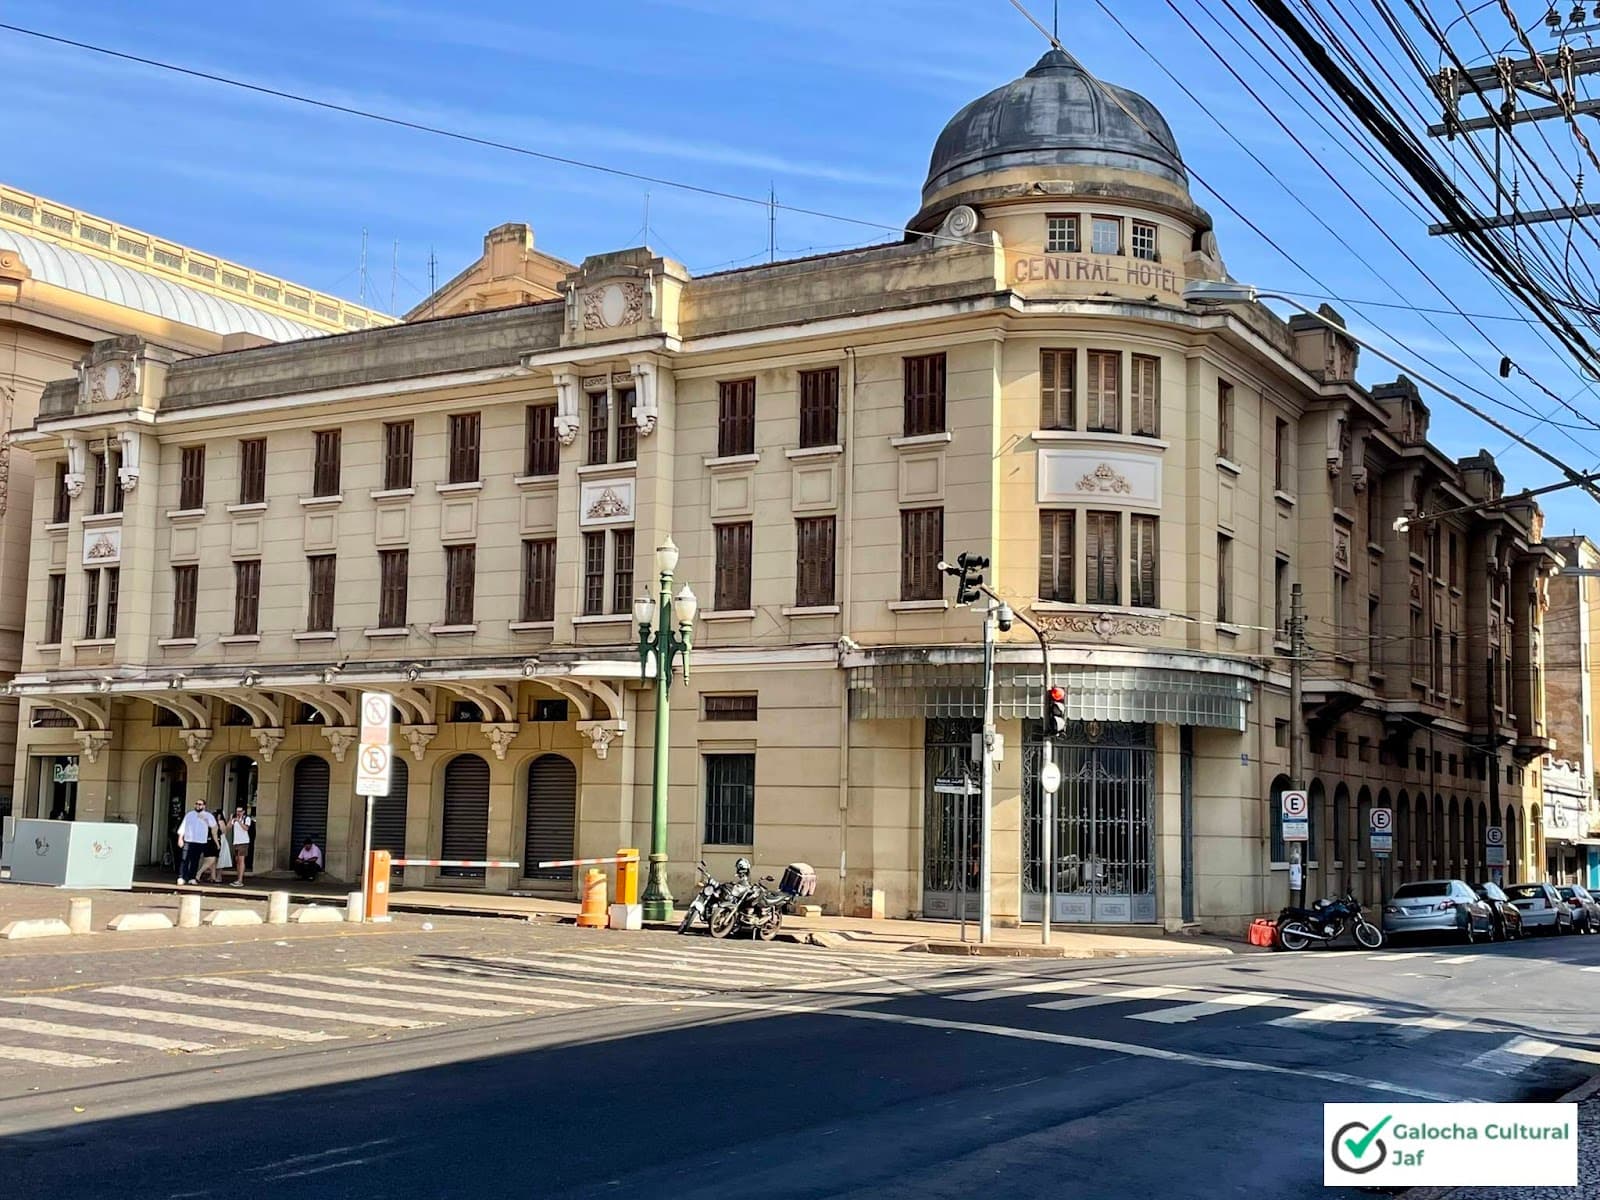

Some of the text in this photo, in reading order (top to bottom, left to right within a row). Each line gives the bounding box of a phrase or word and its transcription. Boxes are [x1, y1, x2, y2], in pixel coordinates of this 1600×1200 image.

[1015, 256, 1181, 295] CENTRAL HOTEL
[1290, 798, 1299, 810] E
[1377, 813, 1385, 825] E
[1492, 831, 1498, 840] E
